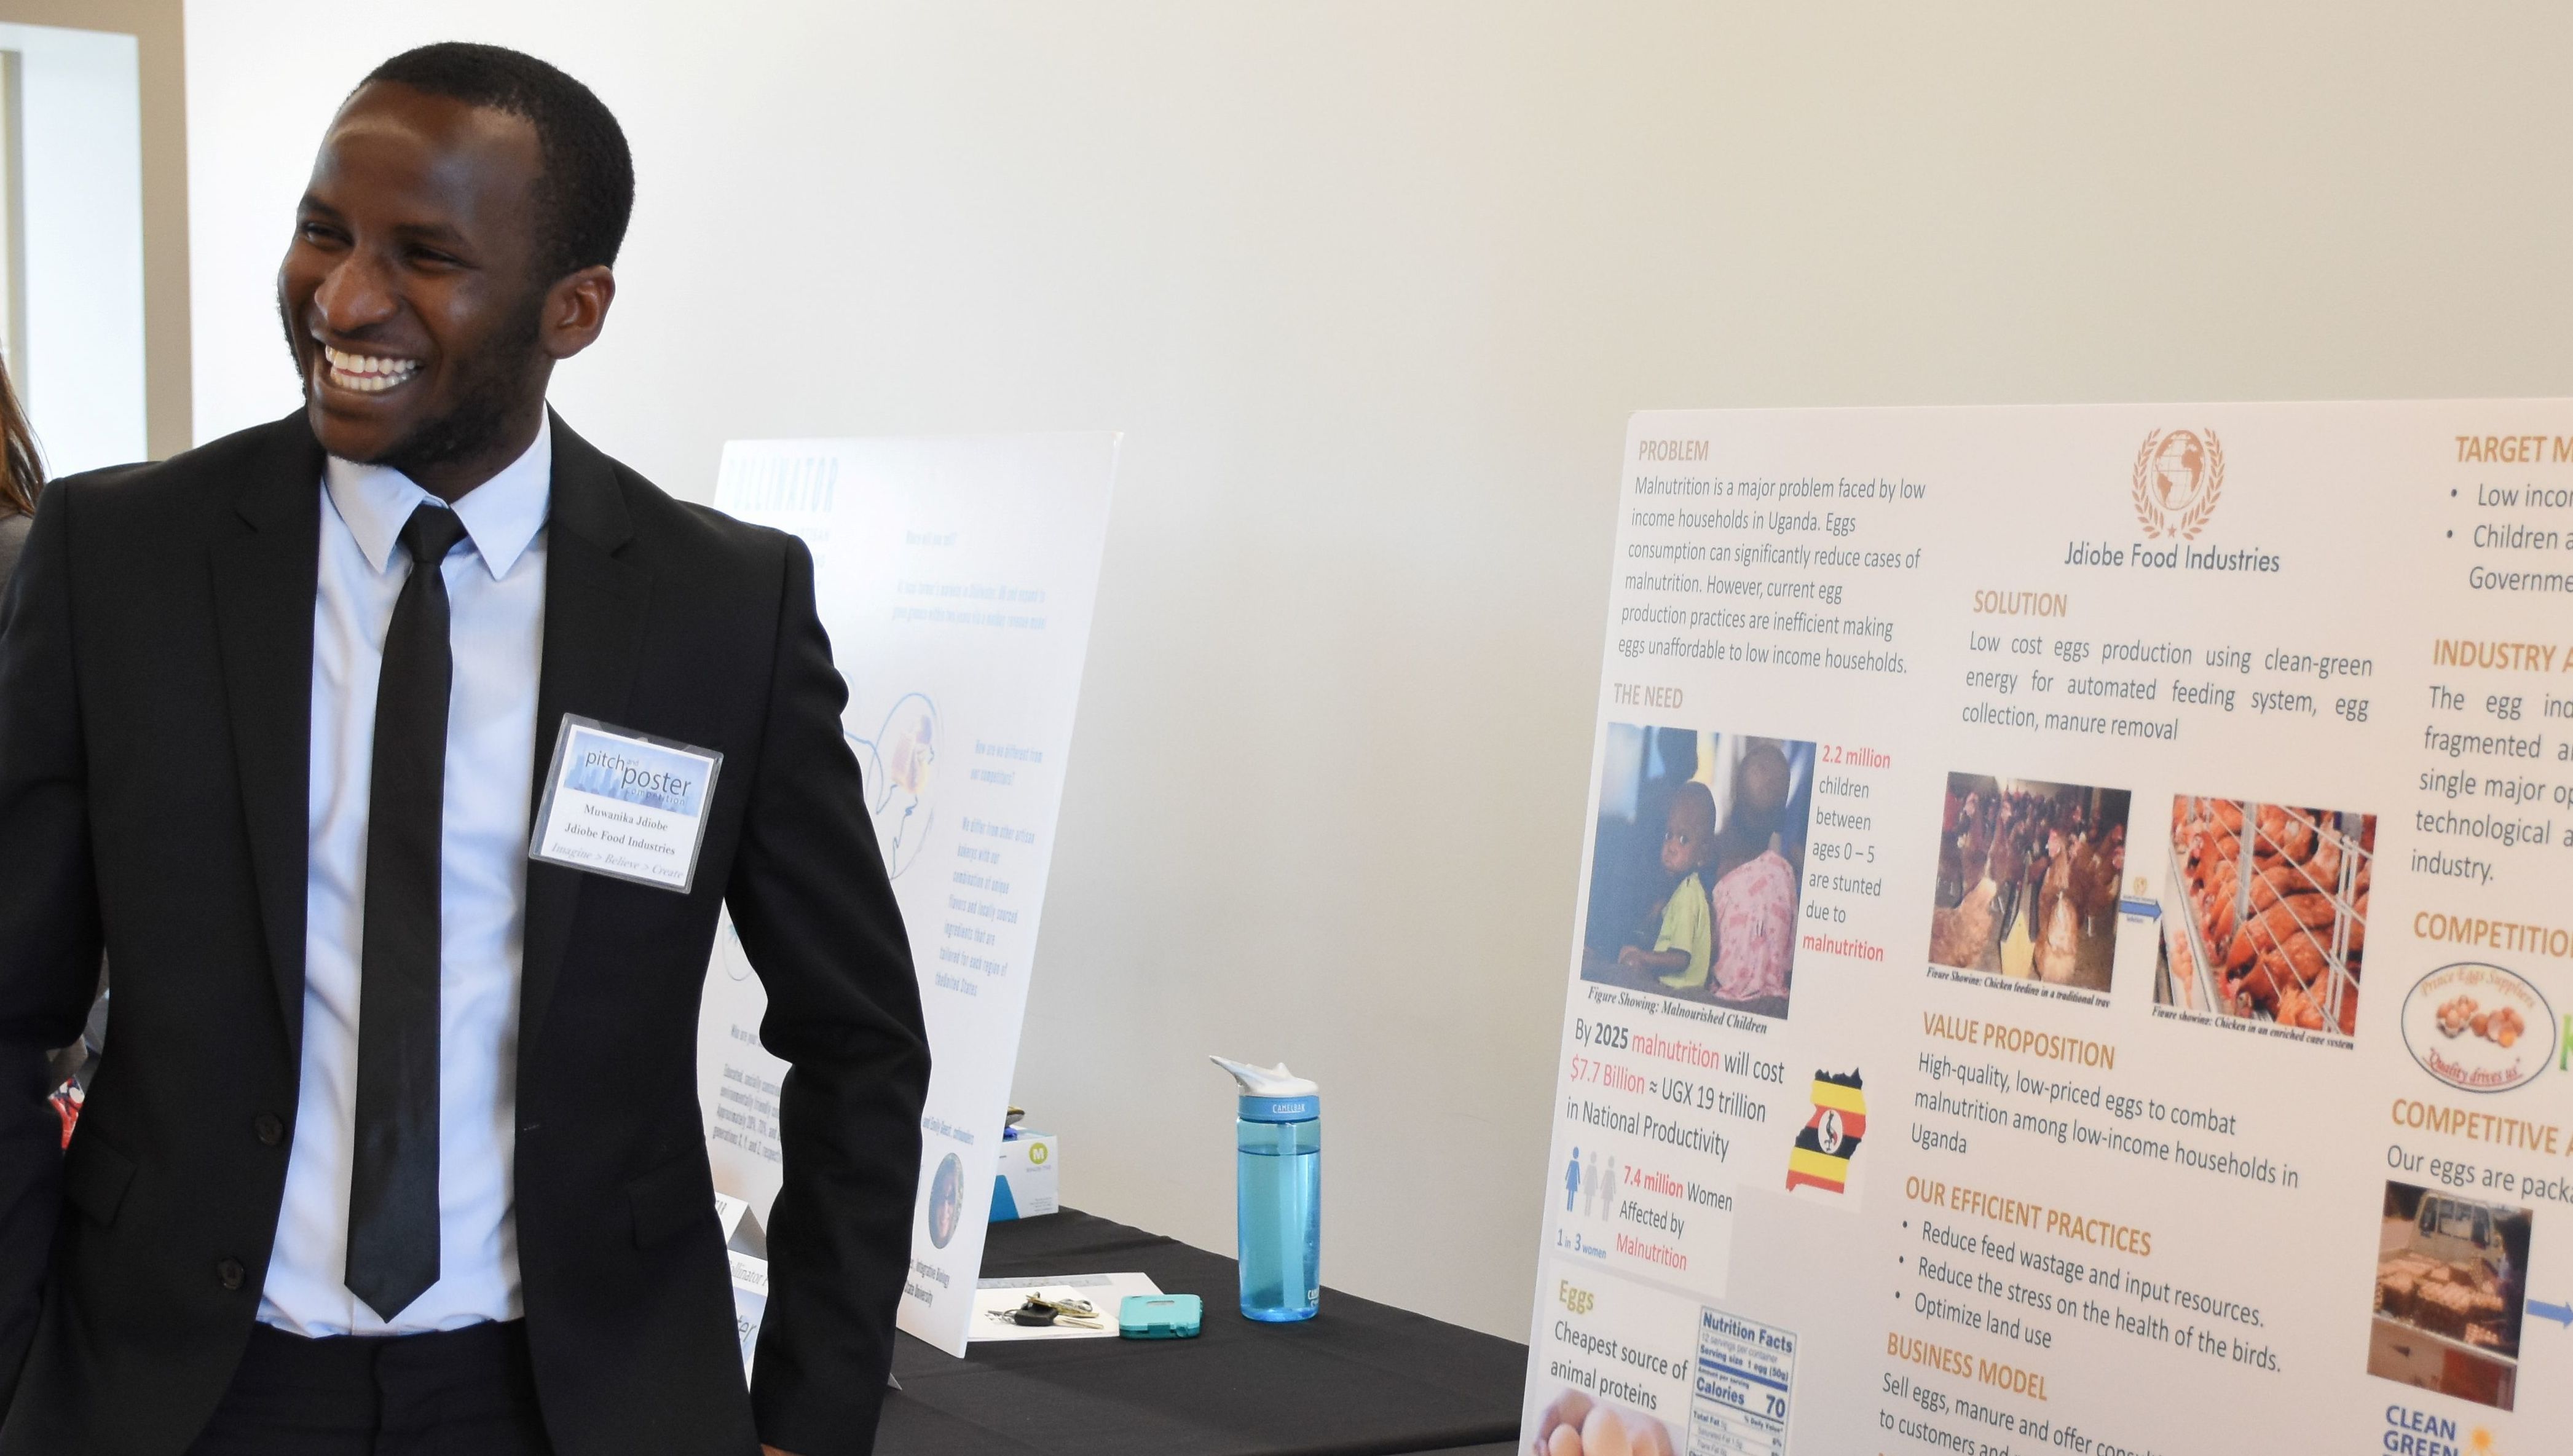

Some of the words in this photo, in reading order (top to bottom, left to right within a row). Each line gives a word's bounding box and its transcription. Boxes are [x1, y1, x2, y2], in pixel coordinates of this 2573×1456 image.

[1639, 440, 1709, 461] PROBLEM
[2456, 436, 2548, 463] TARGET
[1636, 476, 1709, 495] Malnutrition
[1714, 482, 1723, 495] is
[1727, 482, 1733, 495] a
[1738, 482, 1776, 501] major
[1779, 478, 1834, 501] problem
[1839, 478, 1875, 498] faced
[1880, 478, 1896, 503] by
[1901, 478, 1925, 498] low
[2478, 484, 2519, 506] Low
[1632, 508, 1674, 527] income
[1679, 508, 1748, 529] households
[1753, 511, 1763, 529] in
[1769, 511, 1820, 534] Uganda.
[1826, 513, 1855, 537] Eggs
[2474, 524, 2558, 549] Children
[2065, 541, 2124, 566] Jdiobe
[2132, 543, 2178, 568] Food
[2186, 545, 2279, 572] Industries
[1974, 590, 2067, 617] SOLUTION
[1971, 631, 2000, 651] Low
[2012, 636, 2043, 655] cost
[2054, 641, 2089, 663] eggs
[2102, 640, 2191, 664] production
[2206, 646, 2252, 674] using
[2265, 648, 2372, 679] clean-green
[2433, 639, 2556, 672] INDUSTRY
[1614, 683, 1641, 705] THE
[1645, 686, 1683, 709] NEED
[2429, 685, 2464, 710] The
[2486, 696, 2522, 720] egg
[1822, 745, 1842, 763] 2.2
[1846, 748, 1890, 769] million
[2425, 725, 2541, 758] fragmented
[585, 750, 625, 771] pitch
[621, 767, 691, 797] poster
[1819, 776, 1869, 798] children
[2419, 768, 2476, 798] single
[2485, 776, 2546, 805] major
[586, 805, 633, 824] Muwanika
[636, 817, 668, 830] Jdiobe
[1816, 806, 1870, 830] between
[2416, 810, 2550, 846] technological
[565, 823, 597, 838] Jdiobe
[601, 831, 625, 844] Food
[628, 836, 674, 854] Industries
[2412, 849, 2493, 885] industry.
[1803, 934, 1883, 961] malnutrition
[2414, 911, 2573, 958] COMPETITIO
[1984, 977, 2012, 991] Chicken
[1588, 986, 1617, 1004] Figure
[1618, 992, 1659, 1015] Showing:
[1661, 1001, 1725, 1025] Malnourished
[1727, 1014, 1767, 1034] Children
[2215, 1017, 2246, 1031] Chicken
[1575, 1018, 1591, 1047] By
[1594, 1023, 1628, 1049] 2025
[1632, 1033, 1719, 1069] malnutrition
[1725, 1052, 1749, 1076] will
[1754, 1061, 1784, 1084] cost
[1924, 1012, 1979, 1044] VALUE
[1984, 1023, 2114, 1069] PROPOSITION
[1570, 1054, 1600, 1083] $7.7
[1604, 1064, 1644, 1094] Billion
[1663, 1077, 1693, 1106] UGX
[1697, 1086, 1714, 1109] 19
[1719, 1092, 1765, 1122] trillion
[1919, 1052, 2009, 1093] High-quality,
[2017, 1070, 2100, 1108] low-priced
[2106, 1095, 2142, 1119] eggs
[2149, 1100, 2165, 1120] to
[2171, 1108, 2236, 1135] combat
[1567, 1096, 1578, 1120] in
[1583, 1101, 1639, 1135] National
[1644, 1116, 1729, 1163] Productivity
[2392, 1099, 2559, 1154] COMPETITIVE
[2387, 1145, 2424, 1172] Our
[2430, 1159, 2475, 1187] eggs
[2482, 1169, 2514, 1191] are
[1625, 1166, 1641, 1187] 7.4
[1644, 1171, 1683, 1198] million
[1688, 1182, 1732, 1211] Women
[1620, 1200, 1667, 1230] Affected
[1671, 1213, 1684, 1239] by
[1906, 1176, 1945, 1206] OUR
[1951, 1187, 2042, 1229] EFFICIENT
[2046, 1210, 2151, 1256] PRACTICES
[1617, 1233, 1687, 1271] Malnutrition
[1923, 1221, 1976, 1253] Reduce
[1982, 1235, 2015, 1263] feed
[2020, 1250, 2084, 1283] wastage
[2089, 1268, 2120, 1290] and
[2126, 1272, 2170, 1303] input
[2175, 1289, 2263, 1328] resources.
[1559, 1280, 1594, 1315] Eggs
[1703, 1312, 1755, 1342] Nutrition
[1759, 1329, 1792, 1353] Facts
[1555, 1321, 1617, 1358] Cheapest
[1621, 1347, 1668, 1375] source
[1673, 1360, 1688, 1380] of
[1888, 1332, 1972, 1379] BUSINESS
[1979, 1359, 2047, 1401] MODEL
[1551, 1360, 1596, 1389] animal
[1599, 1378, 1657, 1410] proteins
[1754, 1364, 1767, 1375] egg
[1696, 1377, 1744, 1405] Calories
[1767, 1395, 1786, 1418] 70
[1883, 1373, 1909, 1398] Sell
[1913, 1387, 1949, 1415] eggs,
[1955, 1399, 2014, 1431] manure
[2019, 1419, 2049, 1441] and
[2054, 1426, 2092, 1454] offer
[2386, 1406, 2456, 1441] CLEAN
